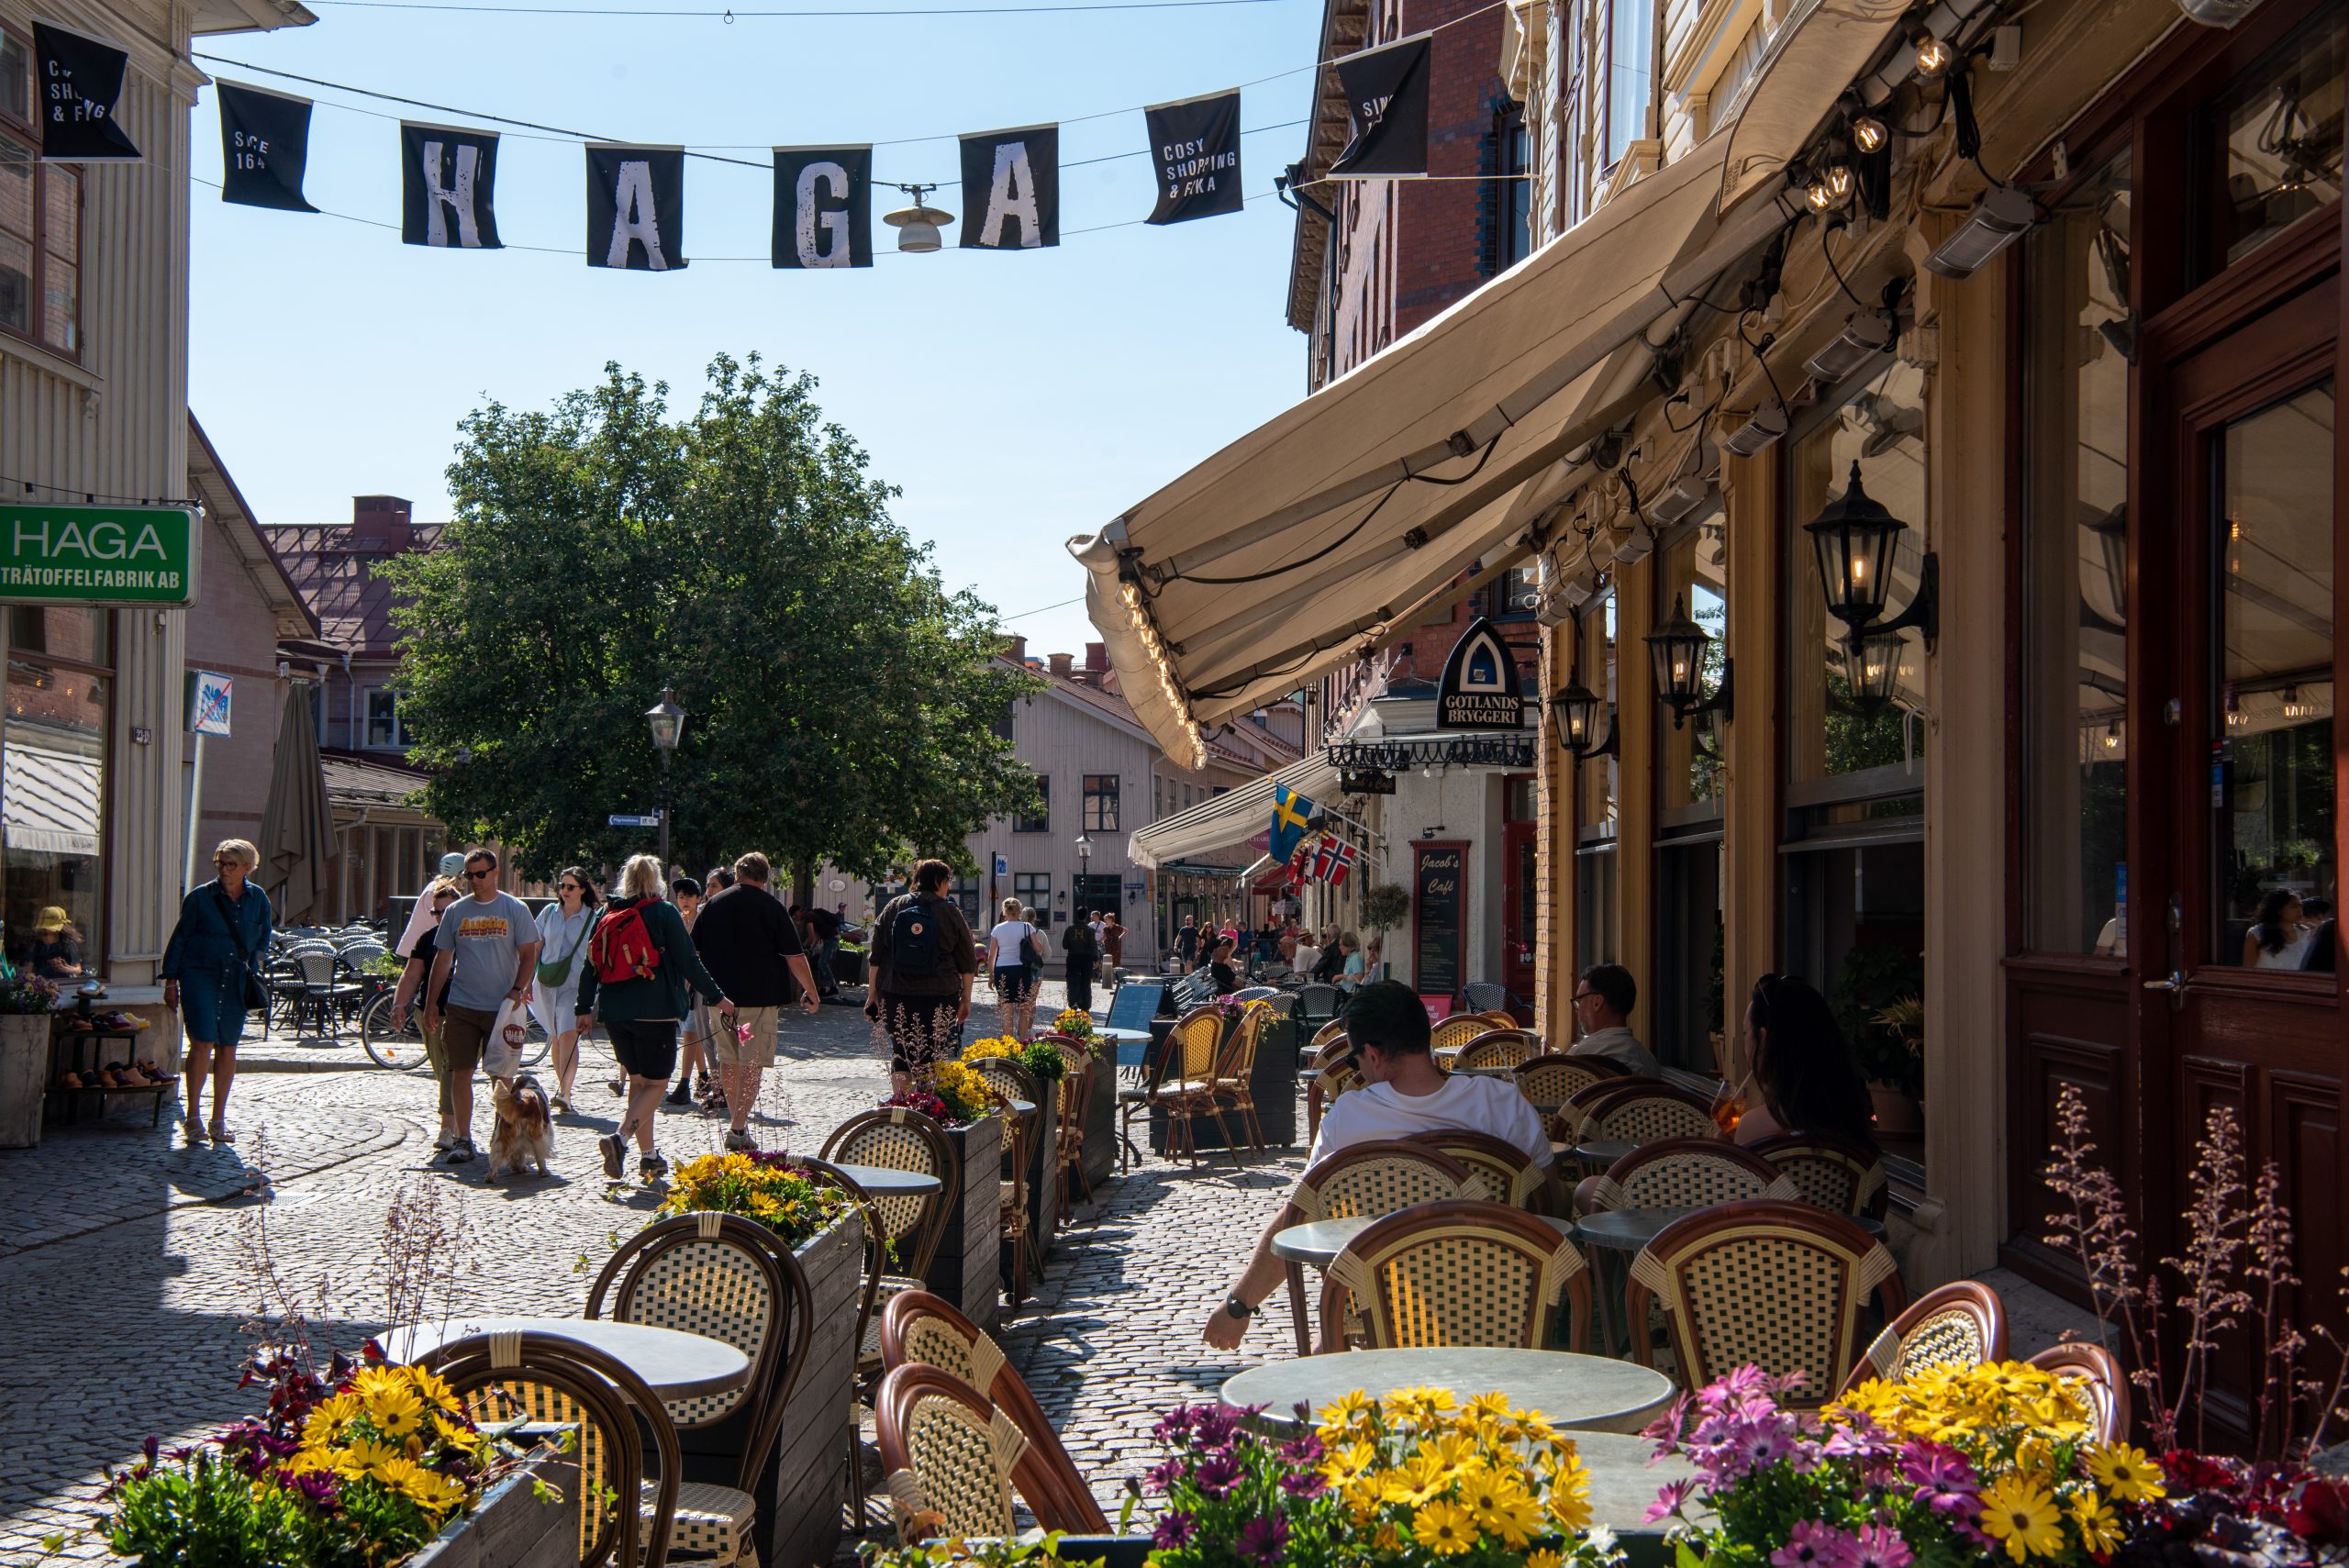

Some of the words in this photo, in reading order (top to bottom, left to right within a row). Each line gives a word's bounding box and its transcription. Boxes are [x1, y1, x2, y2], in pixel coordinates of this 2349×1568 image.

[53, 106, 65, 122] &
[1163, 138, 1204, 161] COSY
[1166, 151, 1235, 180] SHOPPING
[1169, 184, 1179, 198] &
[1184, 176, 1216, 197] FIKA
[14, 520, 167, 561] HAGA
[1, 564, 154, 588] TRÄTOFFELFABRIK
[158, 570, 180, 589] AB
[1445, 695, 1519, 710] GOTLANDS
[1448, 709, 1516, 724] BRYGGERI
[1419, 854, 1459, 873] Jacob's
[1428, 878, 1454, 895] Café
[459, 916, 508, 938] Austin
